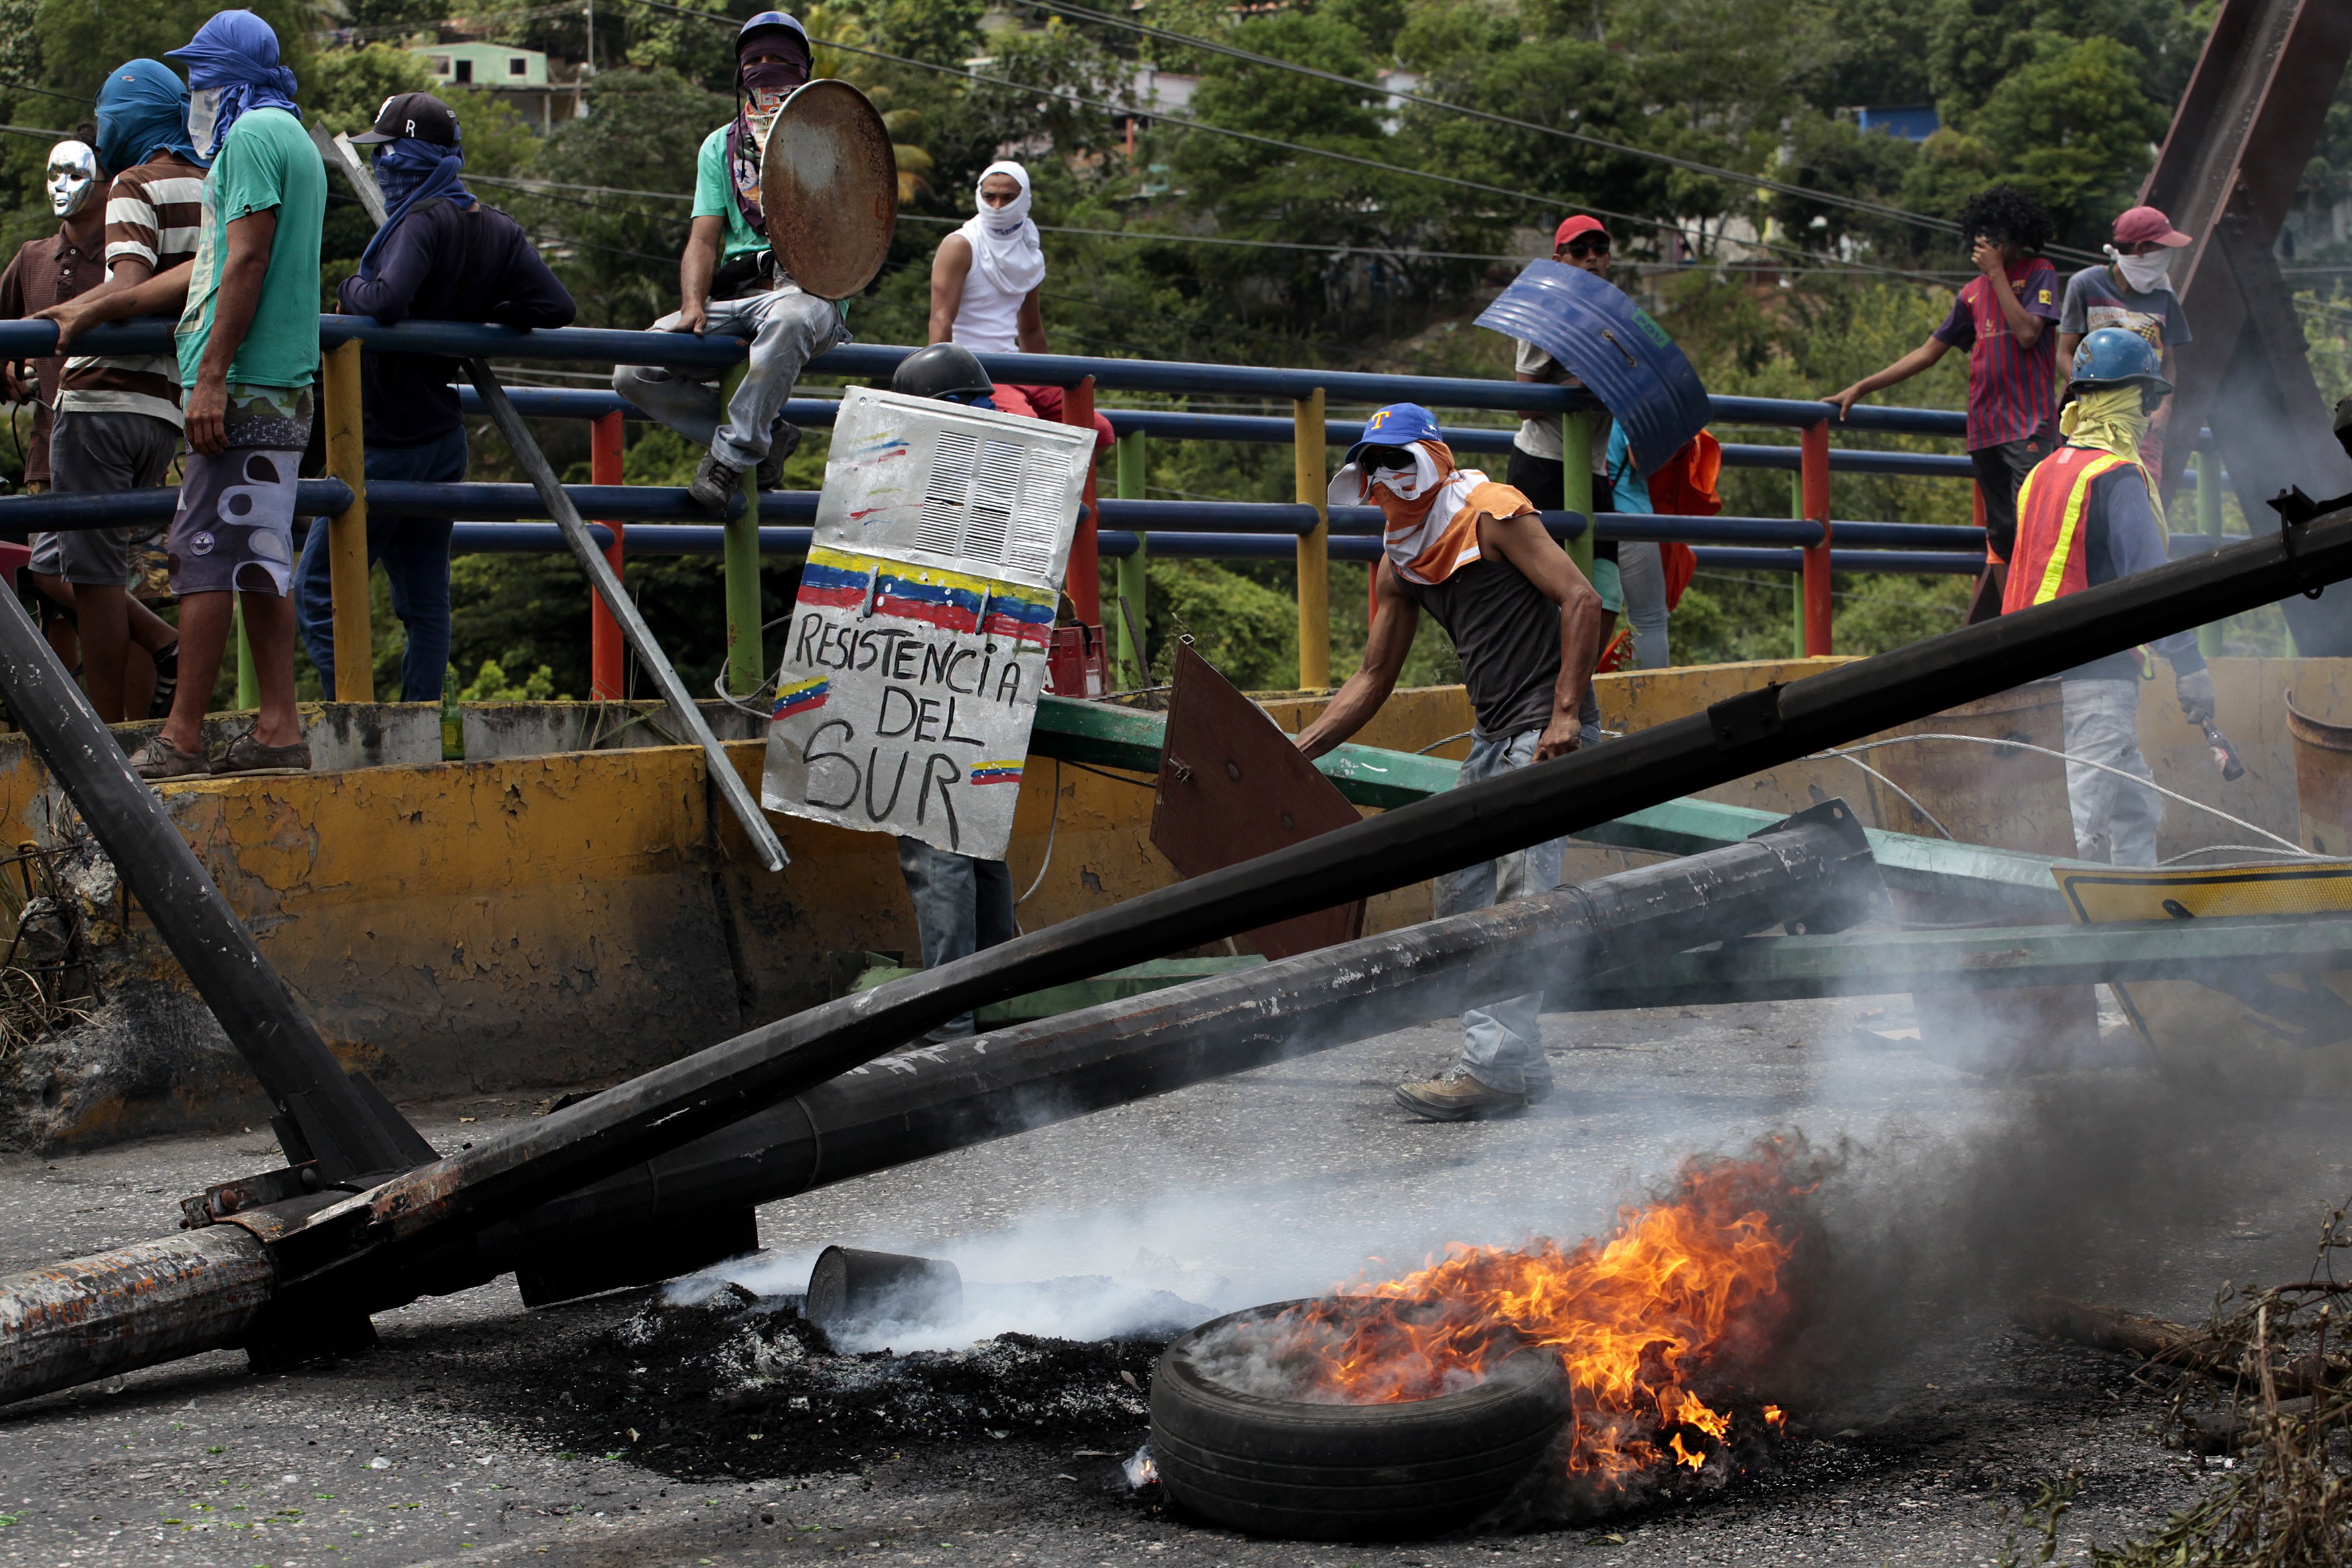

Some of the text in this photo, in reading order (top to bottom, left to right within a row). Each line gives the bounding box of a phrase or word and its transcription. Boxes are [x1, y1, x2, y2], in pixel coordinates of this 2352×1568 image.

[406, 119, 416, 137] R
[1371, 411, 1391, 430] T
[796, 612, 1020, 708] RESISTENCIA
[875, 685, 985, 747] DEL
[803, 718, 961, 852] SUR
